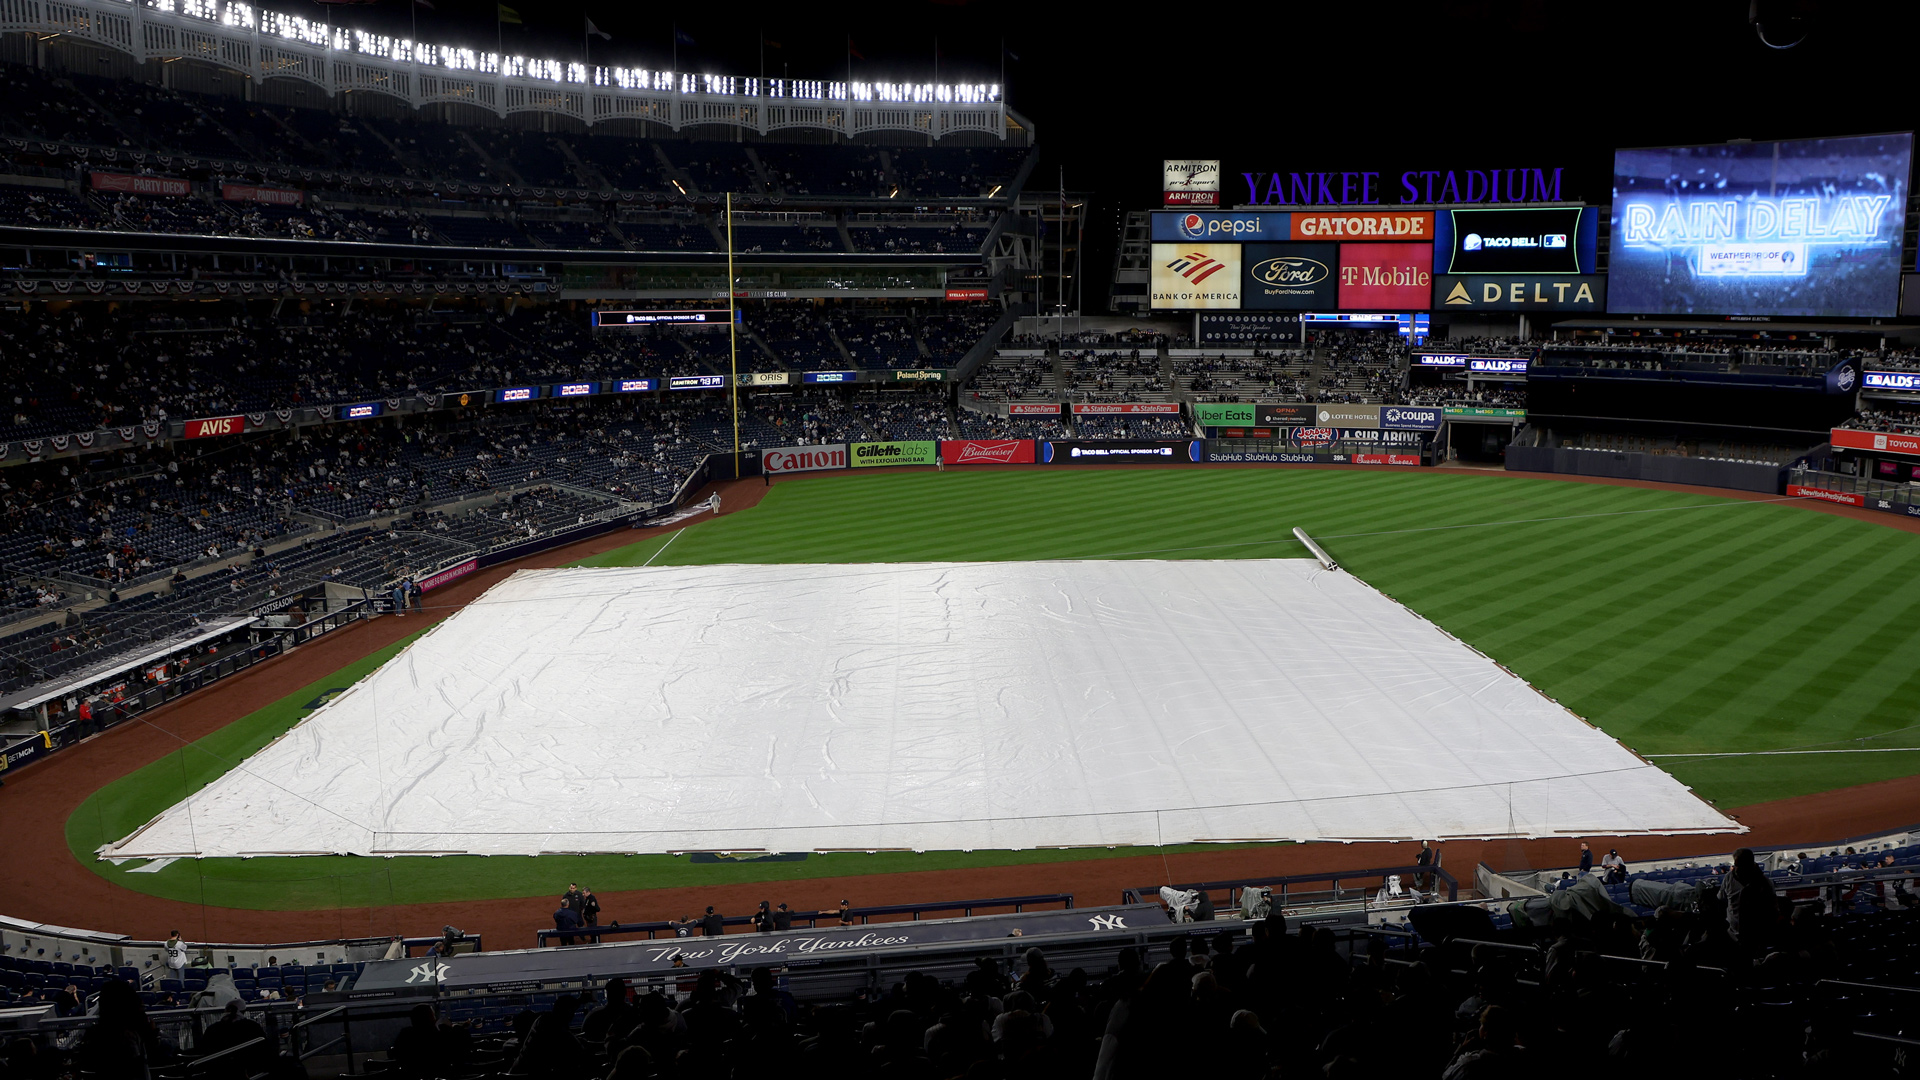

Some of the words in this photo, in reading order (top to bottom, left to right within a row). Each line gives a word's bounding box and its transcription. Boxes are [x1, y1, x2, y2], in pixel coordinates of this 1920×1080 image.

[1166, 164, 1217, 172] ARMITRON
[133, 178, 161, 193] PARTY
[162, 181, 185, 195] DECK
[1241, 171, 1380, 205] YANKEE
[1400, 167, 1564, 204] STADIUM
[256, 190, 279, 201] PARTY
[280, 192, 299, 203] DECK
[1625, 200, 1738, 242] RAIN
[1746, 195, 1892, 240] DELAY
[1208, 217, 1261, 236] pepsi
[1300, 217, 1424, 236] GATORADE
[1483, 237, 1511, 247] TACO
[1511, 236, 1538, 247] BELL
[1710, 251, 1780, 260] WEATHERPROOF
[1264, 260, 1316, 282] Ford
[1362, 266, 1430, 286] Mobile
[1264, 288, 1315, 296] BuyFordNow.com
[1483, 282, 1595, 303] DELTA
[1433, 356, 1456, 364] ALDS
[1484, 361, 1511, 371] ALDS
[816, 373, 843, 382] 2022
[896, 371, 919, 380] Poland
[919, 371, 942, 381] Spring
[1882, 376, 1913, 387] ALDS
[562, 385, 590, 396] 2022
[622, 380, 649, 391] 2022
[504, 389, 530, 400] 2022
[350, 406, 372, 417] 2022
[1195, 410, 1223, 420] Uber
[1225, 410, 1252, 420] Eats
[1401, 411, 1435, 424] coupa
[199, 418, 232, 436] AVIS
[1297, 427, 1332, 437] Jersey
[1344, 430, 1350, 445] A
[1354, 430, 1379, 446] SUB
[1382, 430, 1421, 446] ABOVE
[1889, 440, 1918, 449] TOYOTA
[856, 444, 901, 457] Gillette
[901, 444, 928, 456] Labs
[962, 446, 1012, 457] Budweiser
[763, 450, 845, 472] Canon
[1210, 453, 1242, 462] StubHub
[1244, 454, 1278, 462] StubHub
[1280, 454, 1314, 462] StubHub
[424, 580, 434, 589] MORE
[440, 574, 449, 583] BARS
[452, 568, 463, 577] MORE
[463, 562, 475, 573] PLACES
[258, 596, 294, 616] POSTSEASON
[8, 746, 34, 764] BETMGM
[646, 947, 714, 962] New
[716, 938, 791, 964] York
[792, 932, 909, 954] Yankees
[168, 950, 178, 958] 99
